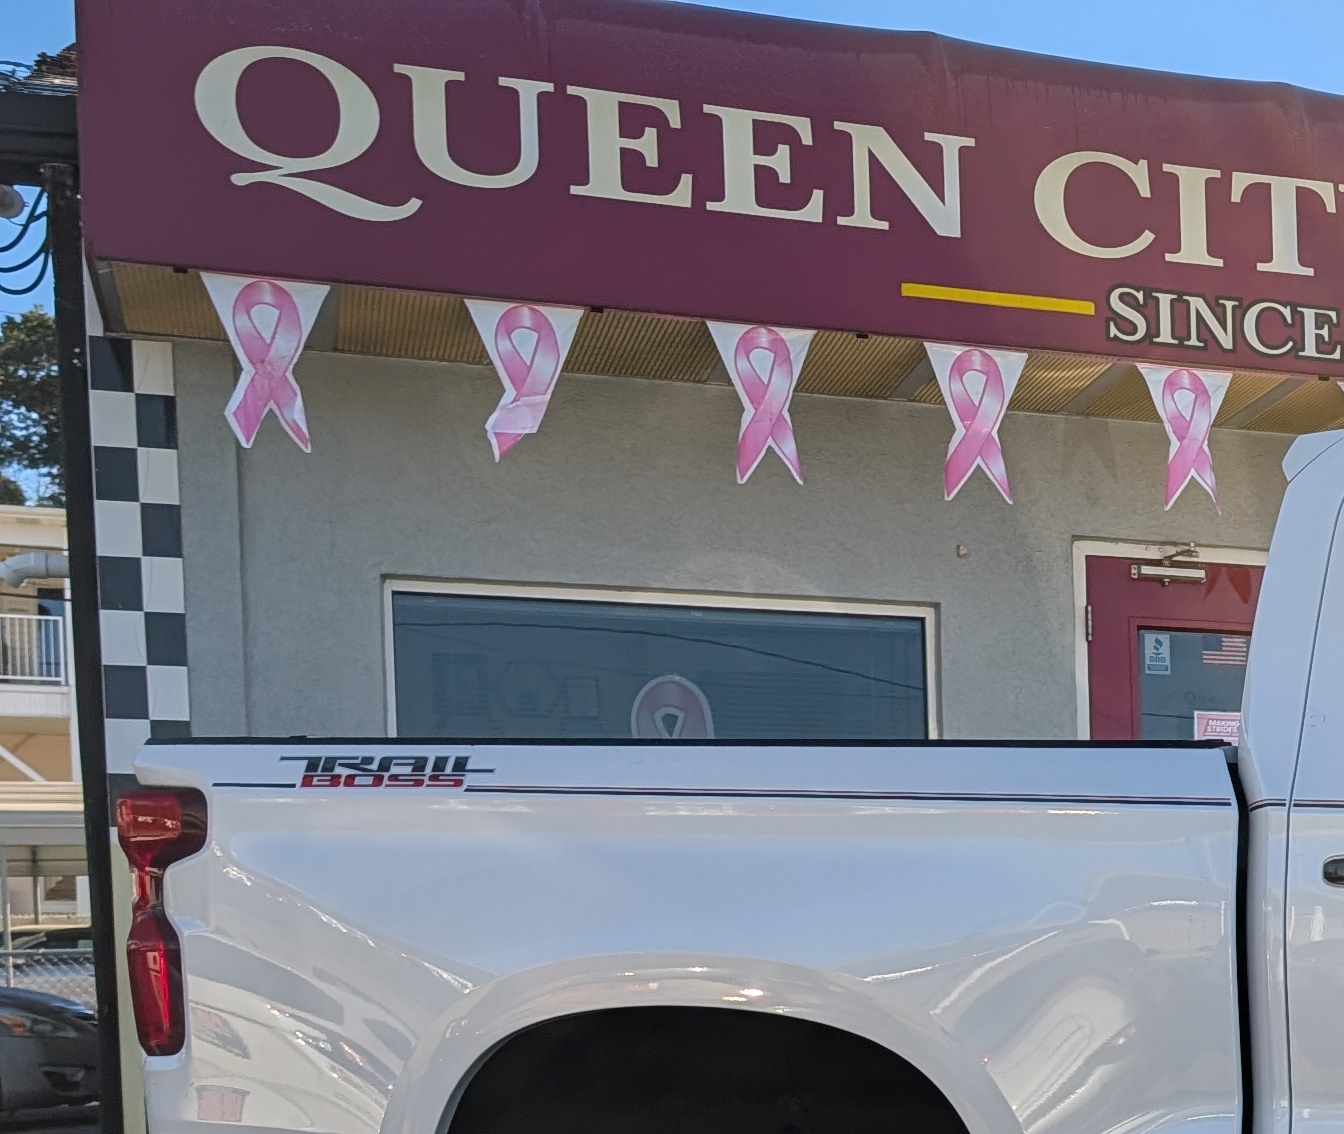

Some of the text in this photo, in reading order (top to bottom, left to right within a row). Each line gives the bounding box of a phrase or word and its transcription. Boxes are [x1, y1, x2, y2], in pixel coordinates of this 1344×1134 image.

[193, 45, 976, 238] QUEEN
[1106, 286, 1341, 360] SINCE
[279, 755, 496, 773] TRAIL
[300, 774, 466, 788] BOSS
